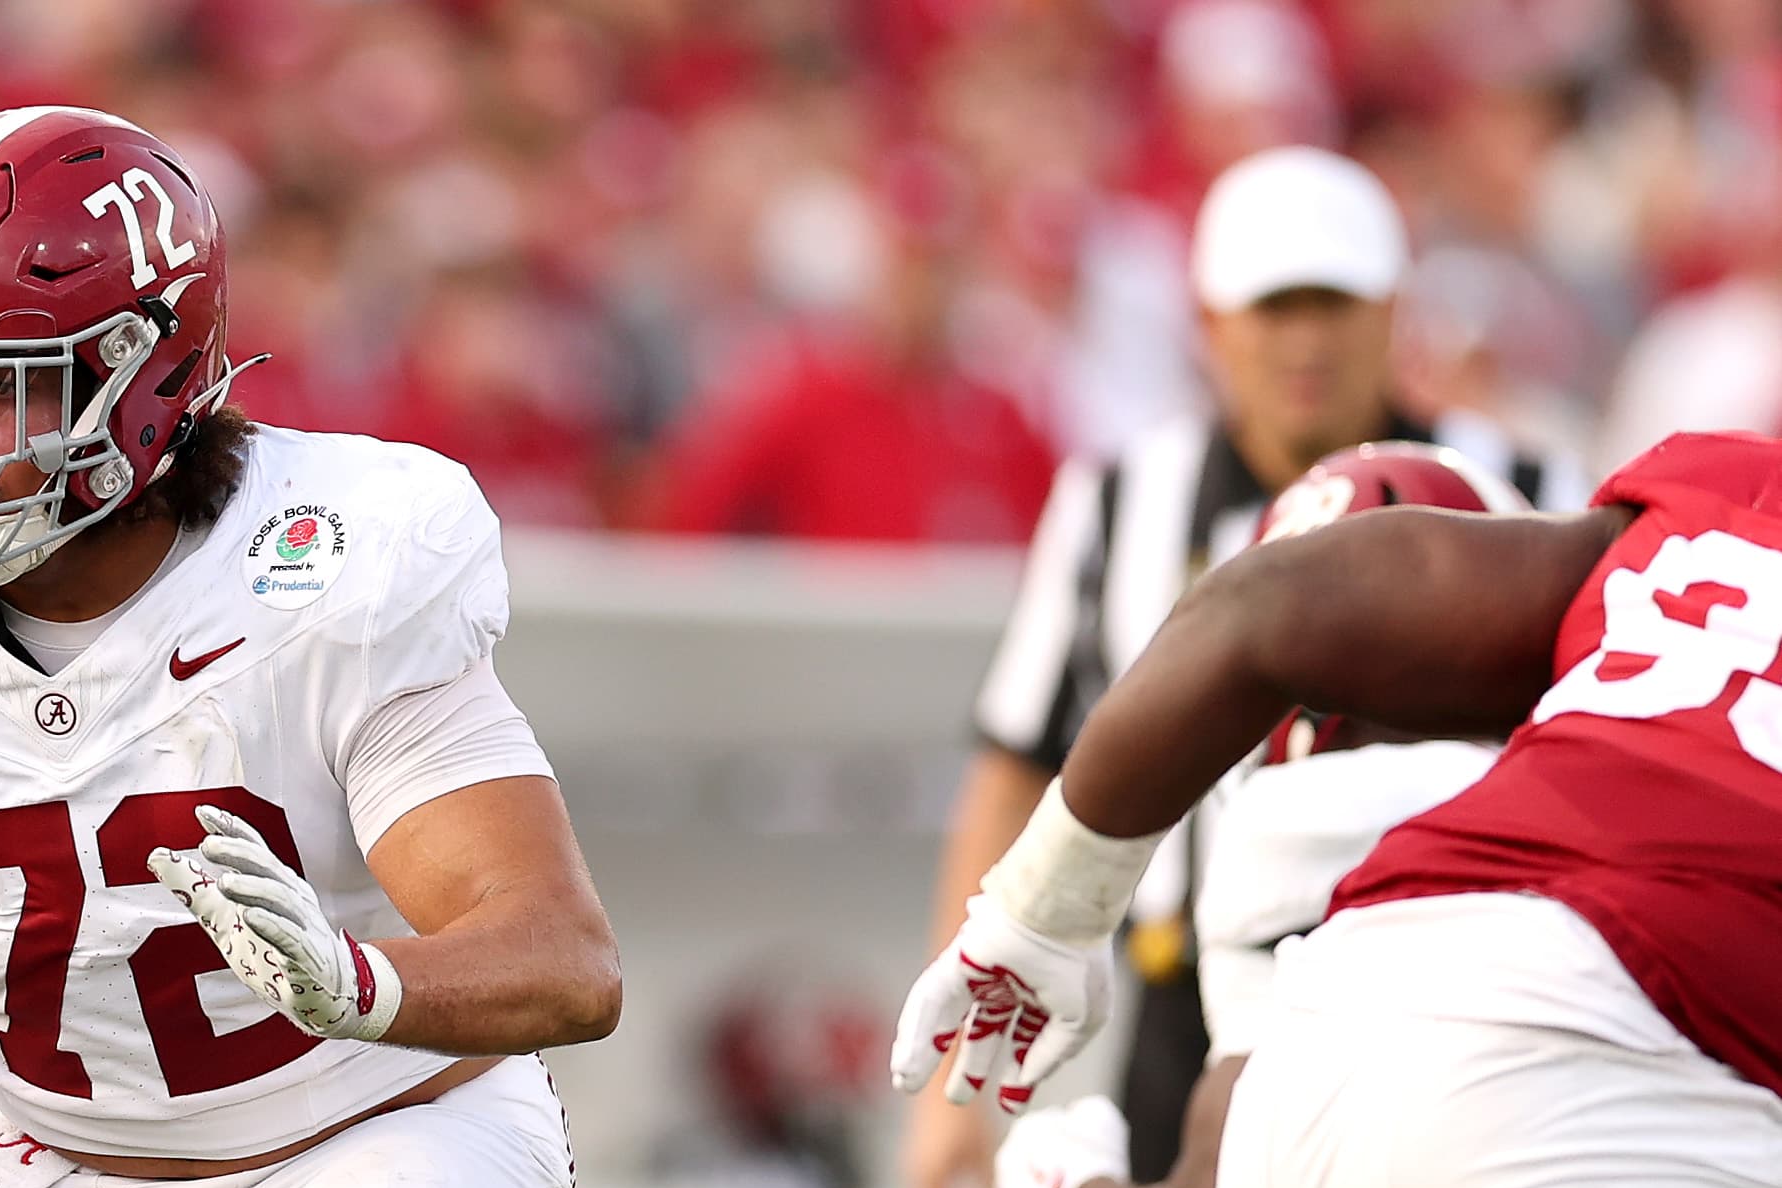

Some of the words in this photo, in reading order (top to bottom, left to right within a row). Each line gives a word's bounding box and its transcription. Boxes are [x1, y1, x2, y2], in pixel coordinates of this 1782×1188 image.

[81, 166, 197, 291] 72
[247, 515, 282, 557] ROSE
[283, 504, 327, 520] BOWL
[327, 512, 346, 556] GAME
[268, 561, 305, 574] presented
[305, 561, 316, 572] by
[271, 579, 324, 592] Prudential
[42, 699, 69, 727] A
